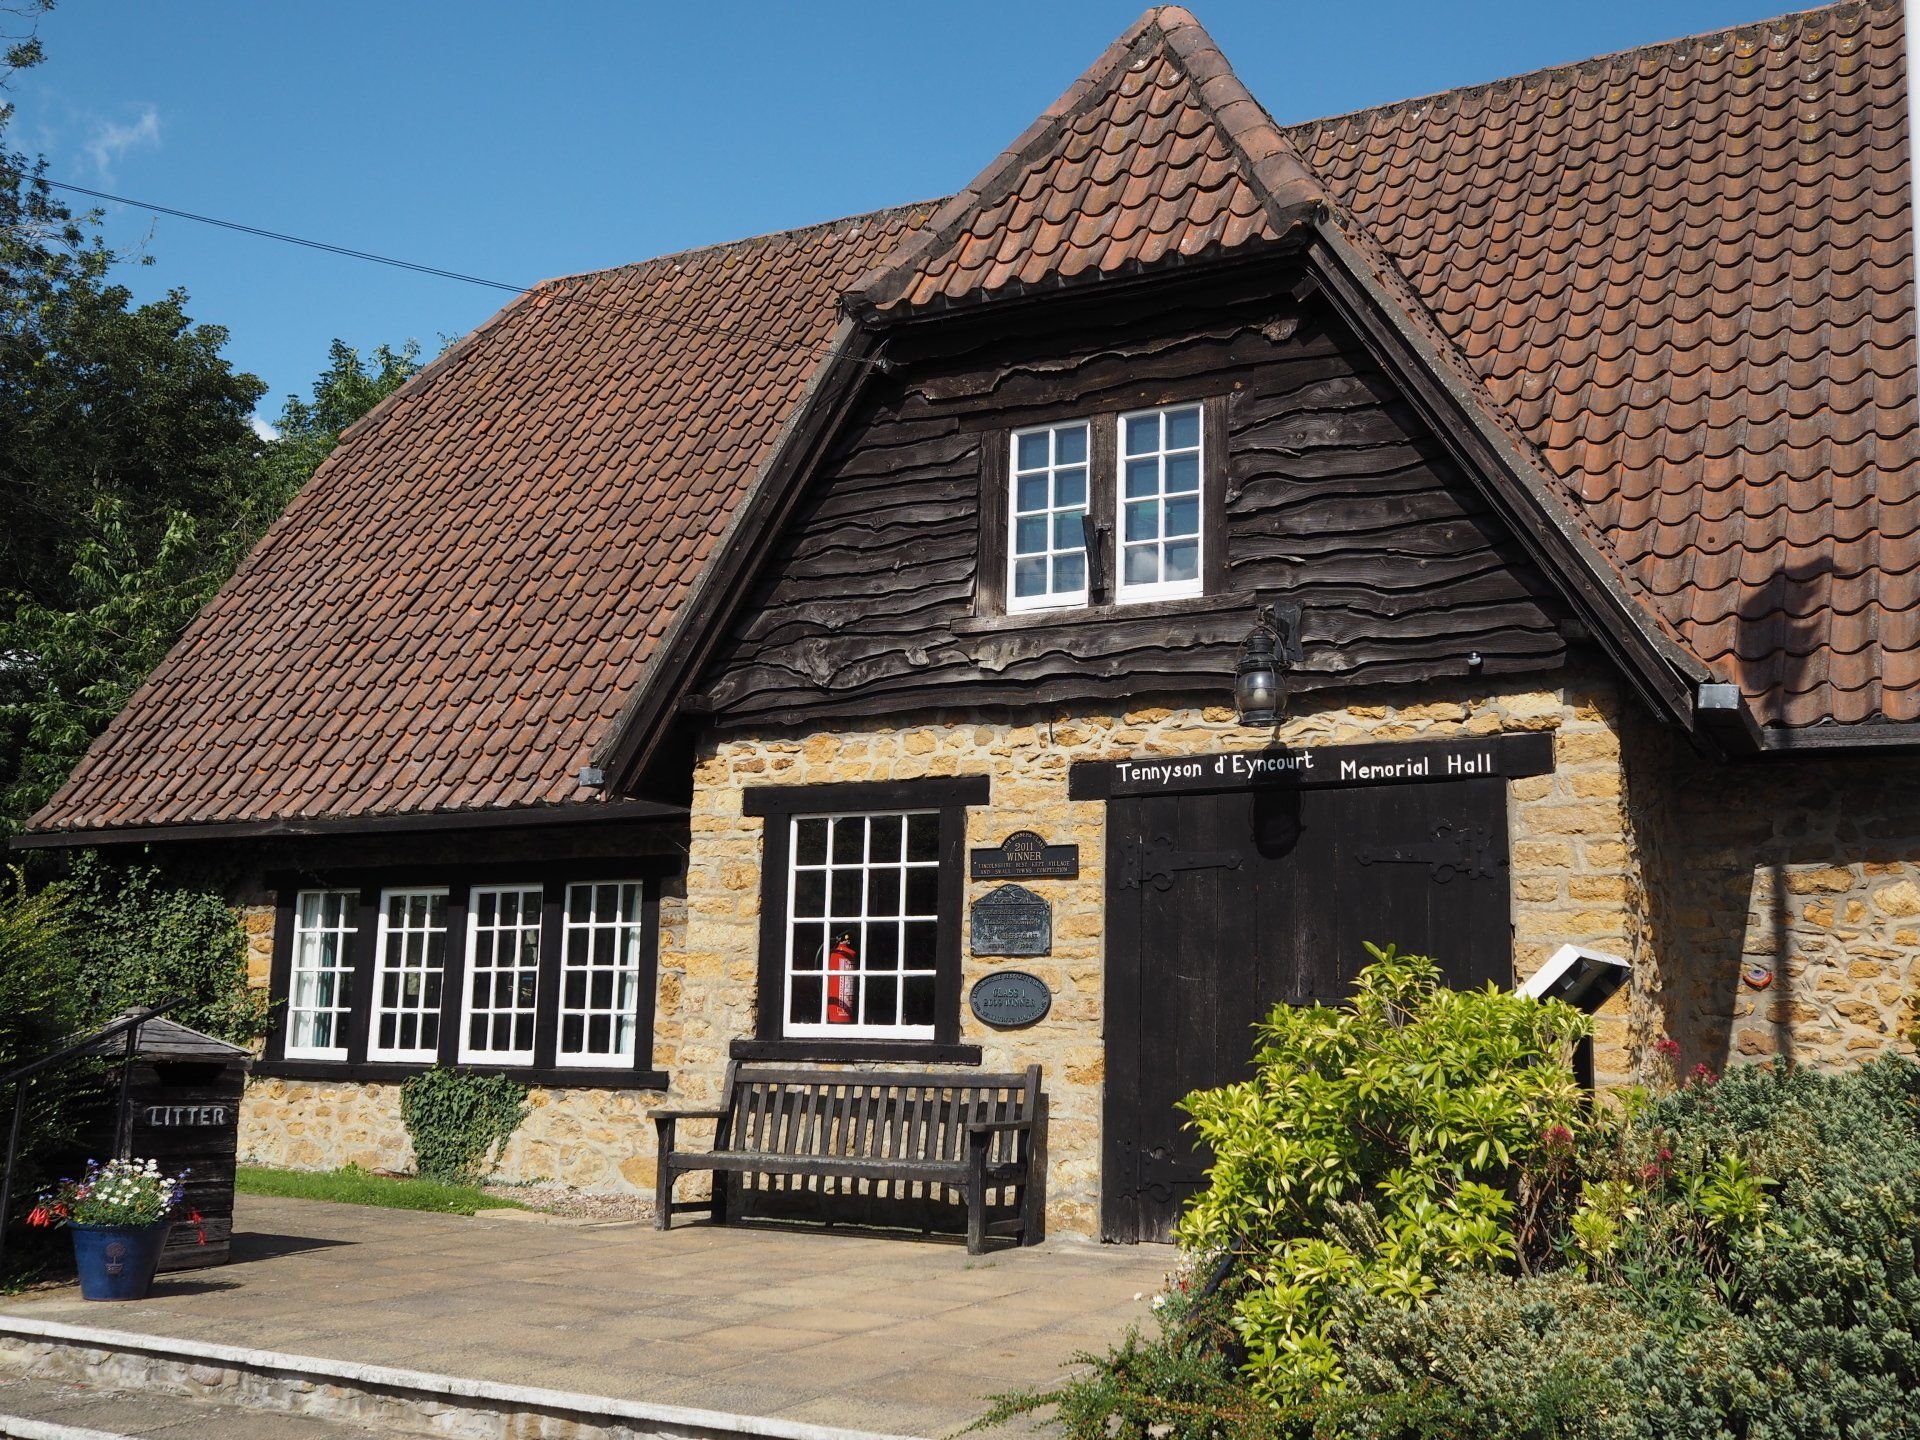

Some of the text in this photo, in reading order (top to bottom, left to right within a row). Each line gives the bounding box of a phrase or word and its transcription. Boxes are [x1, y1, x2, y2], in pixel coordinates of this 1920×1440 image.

[1116, 751, 1492, 784] Tennyson d'Eyncourt Memorial Hall
[1014, 842, 1033, 852] 2011
[1006, 851, 1042, 861] WINNER
[993, 987, 1019, 998] CLASS
[1005, 998, 1036, 1008] WINNER
[151, 1107, 226, 1126] LITTER
